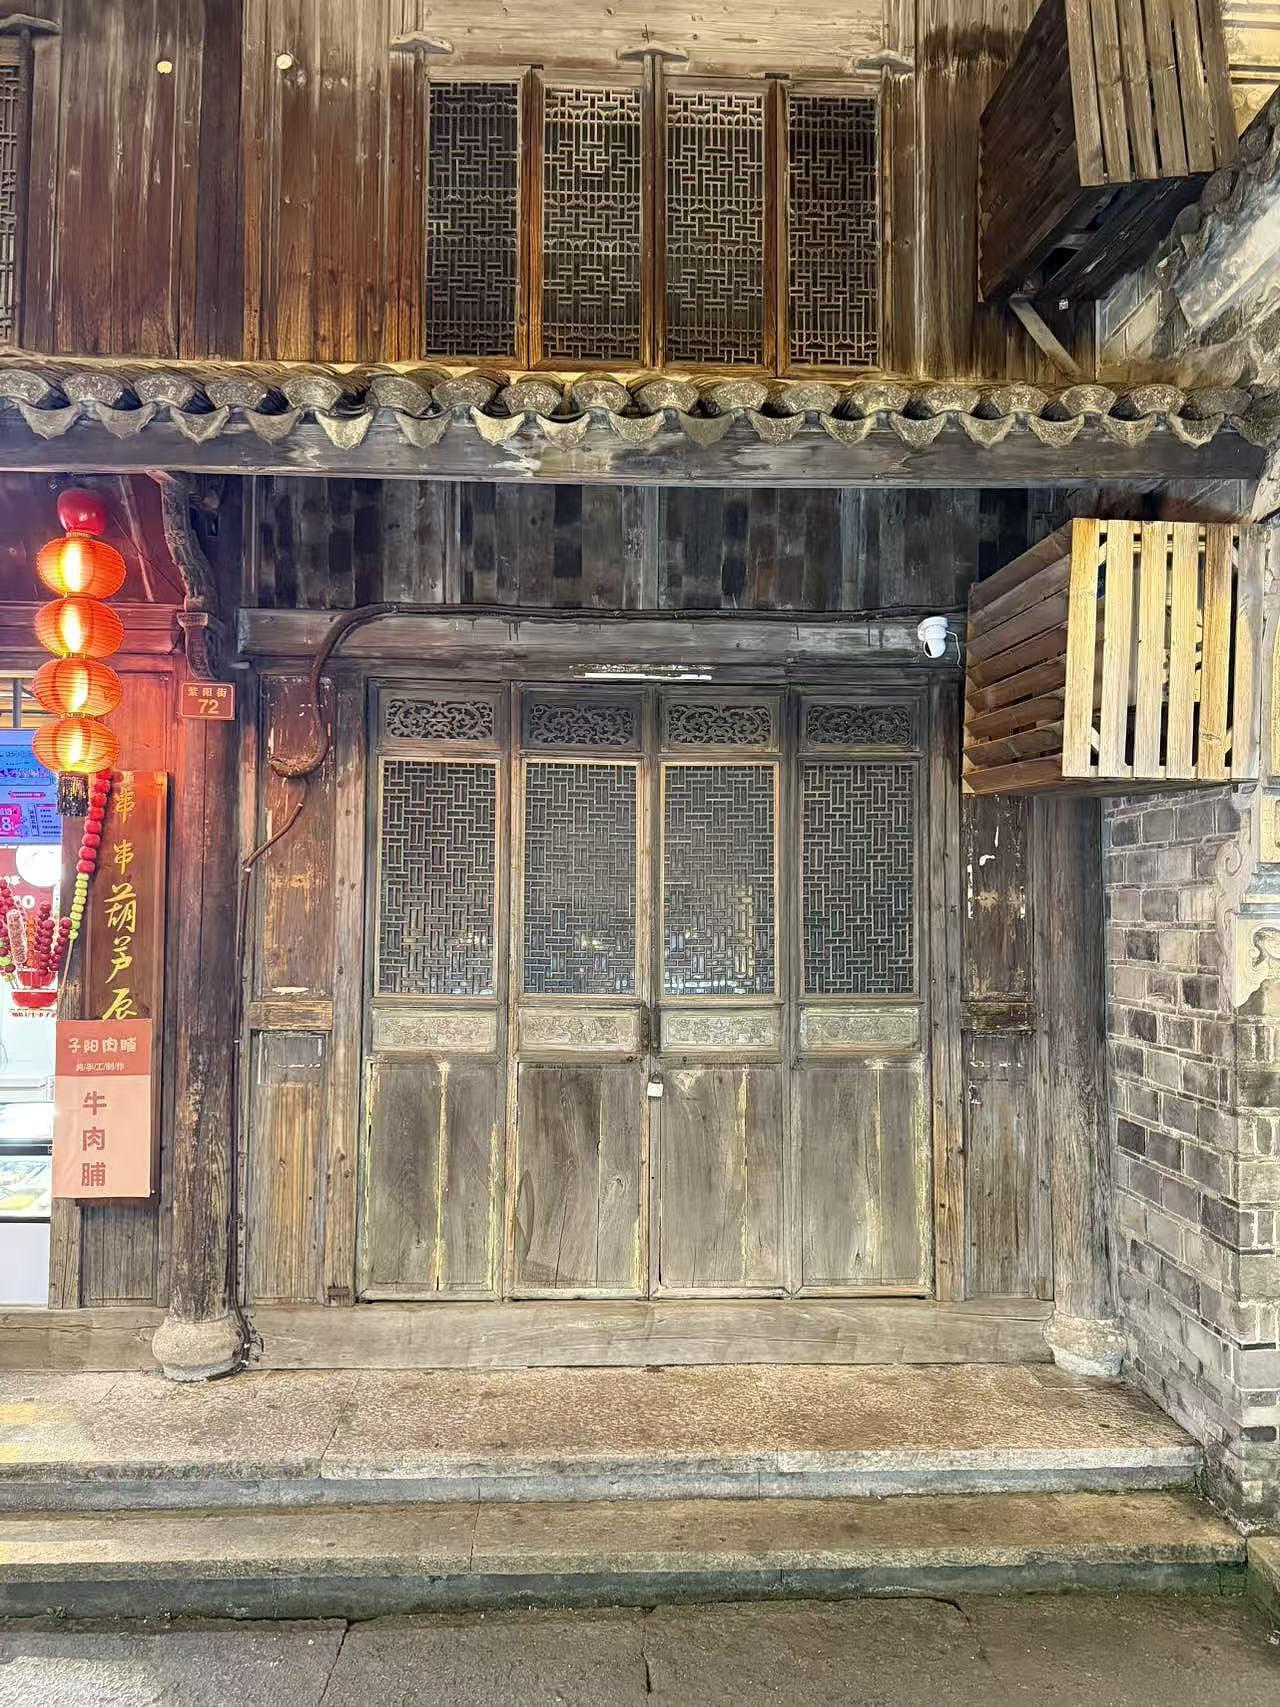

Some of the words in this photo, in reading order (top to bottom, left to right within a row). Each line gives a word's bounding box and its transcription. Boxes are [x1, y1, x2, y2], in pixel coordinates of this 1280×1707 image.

[187, 686, 227, 698] 紫阳街
[198, 698, 219, 714] 72
[81, 1090, 107, 1187] 牛肉脯
